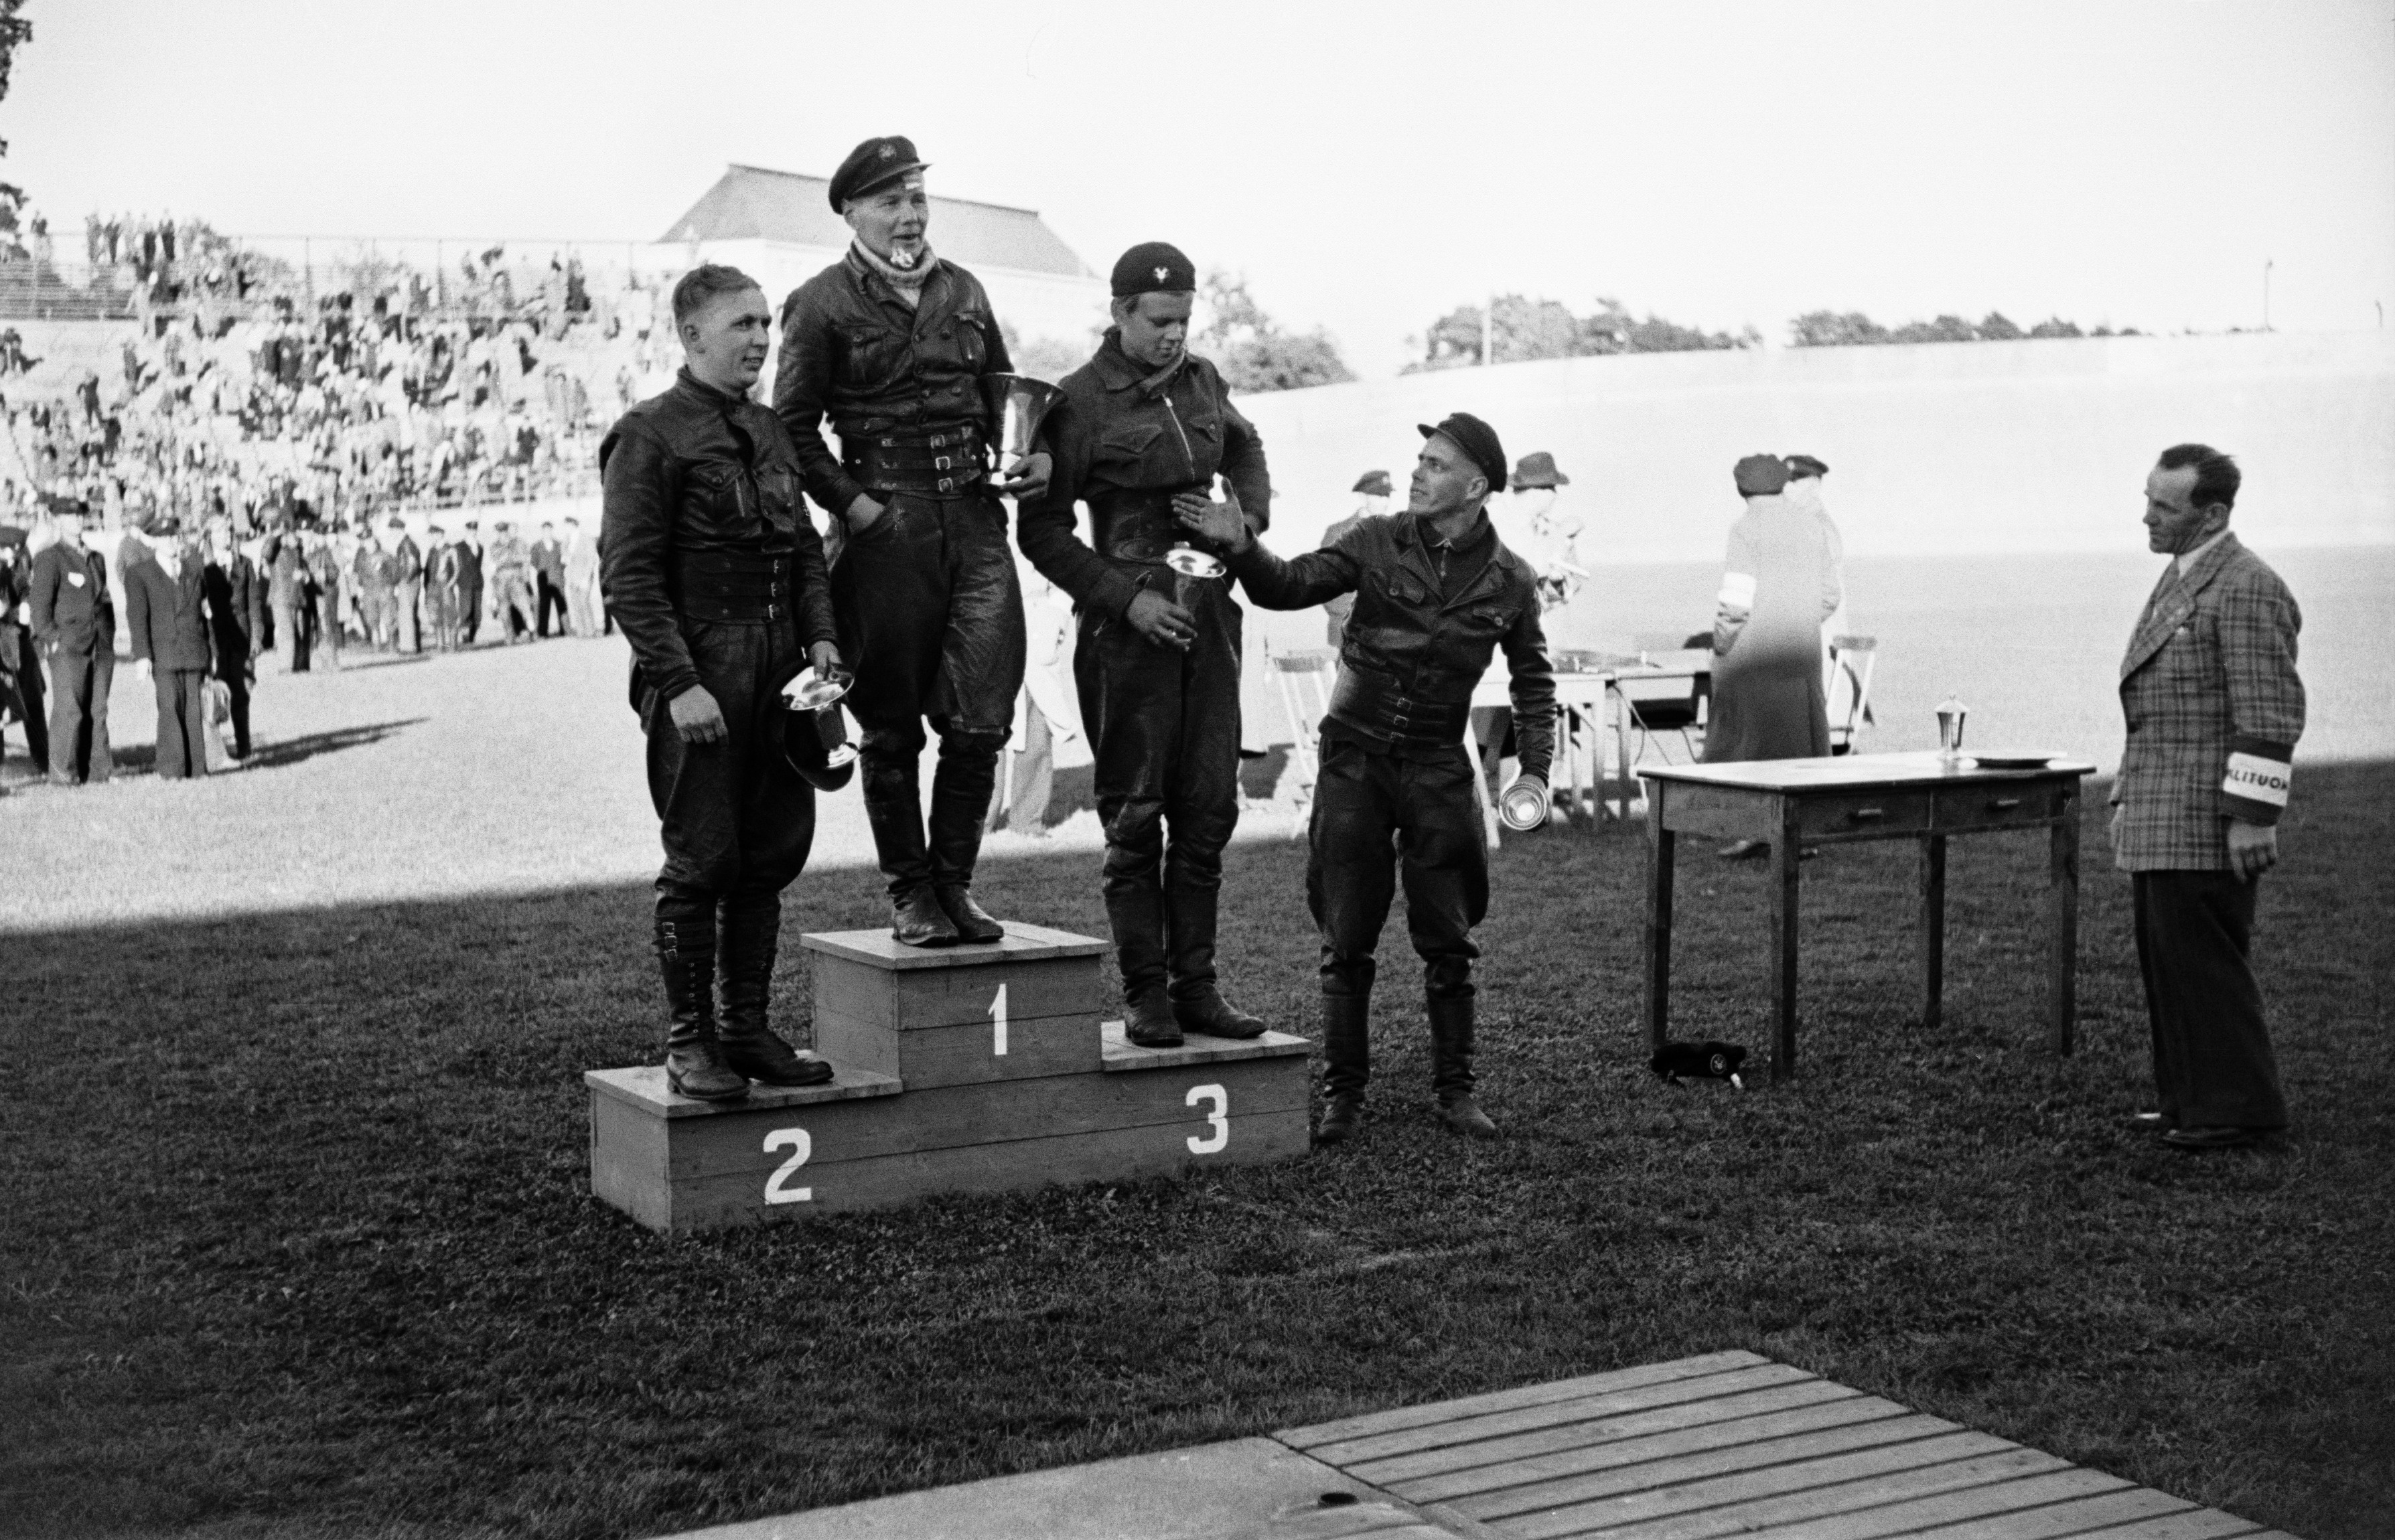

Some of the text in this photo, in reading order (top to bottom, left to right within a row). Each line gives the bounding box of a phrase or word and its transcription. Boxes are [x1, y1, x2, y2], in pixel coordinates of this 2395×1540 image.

[988, 983, 1007, 1056] 1
[1185, 1083, 1229, 1154] 3
[763, 1128, 812, 1205] 2
